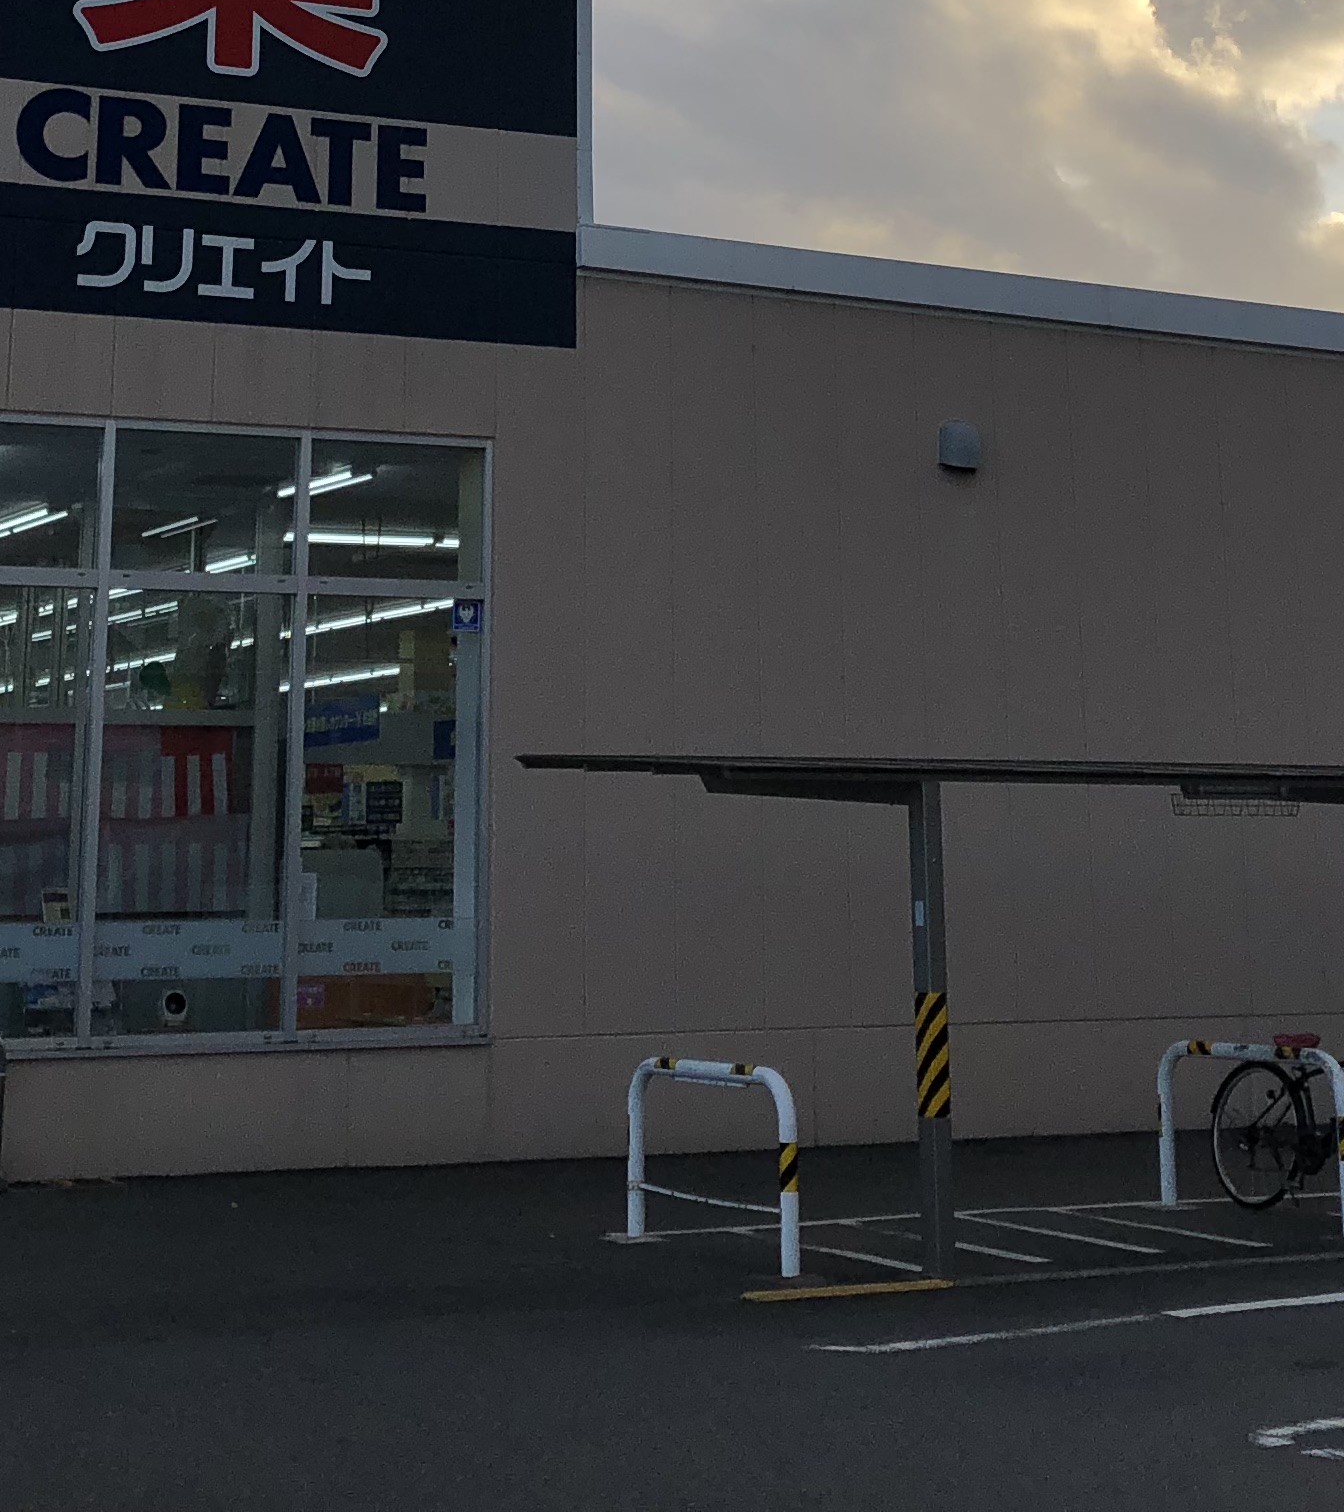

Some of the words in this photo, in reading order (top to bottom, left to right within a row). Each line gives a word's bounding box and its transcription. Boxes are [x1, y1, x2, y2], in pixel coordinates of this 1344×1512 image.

[15, 87, 428, 214] CREATE
[76, 220, 373, 307] クリエイト
[33, 926, 73, 936] CREATE
[344, 963, 381, 973] CREATE
